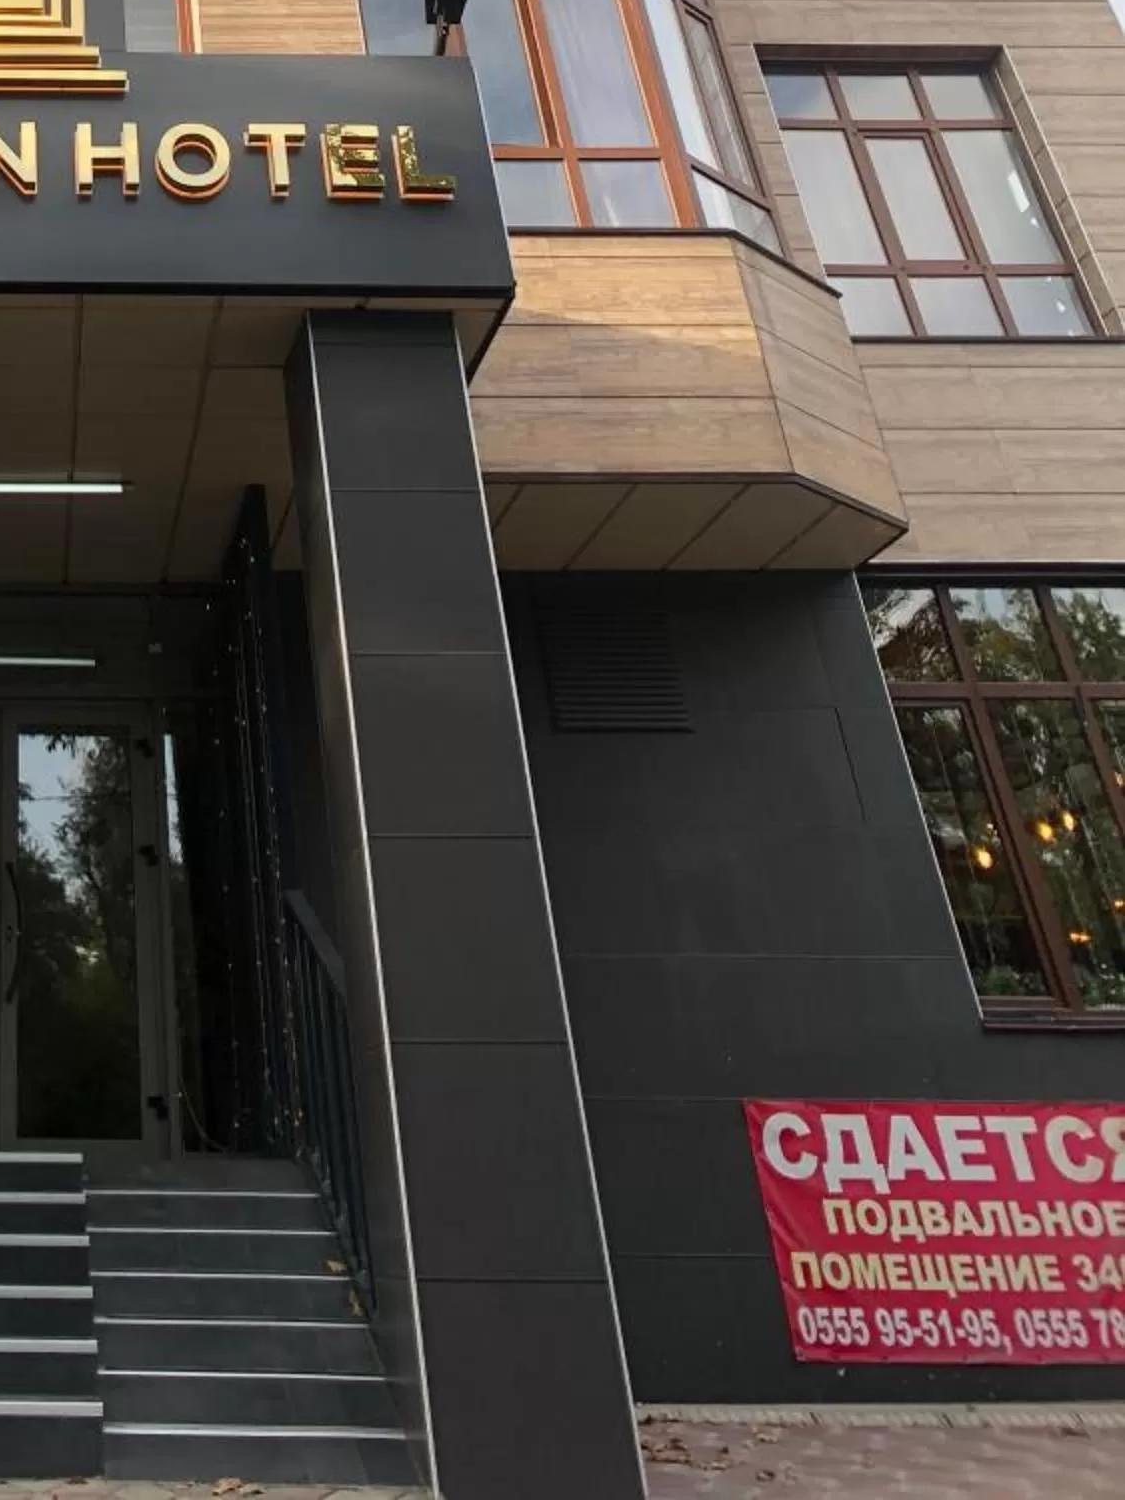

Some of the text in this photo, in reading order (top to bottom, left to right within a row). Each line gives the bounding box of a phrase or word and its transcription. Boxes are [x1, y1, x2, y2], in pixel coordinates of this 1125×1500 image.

[75, 120, 458, 202] HOTEL
[822, 1198, 1125, 1243] ПОДВАЛЬНОЕ
[790, 1251, 1066, 1299] ПОМЕЩЕНИЕ
[797, 1306, 870, 1347] 0555
[878, 1307, 1014, 1356] 95-51-95,
[1014, 1308, 1089, 1349] 0555
